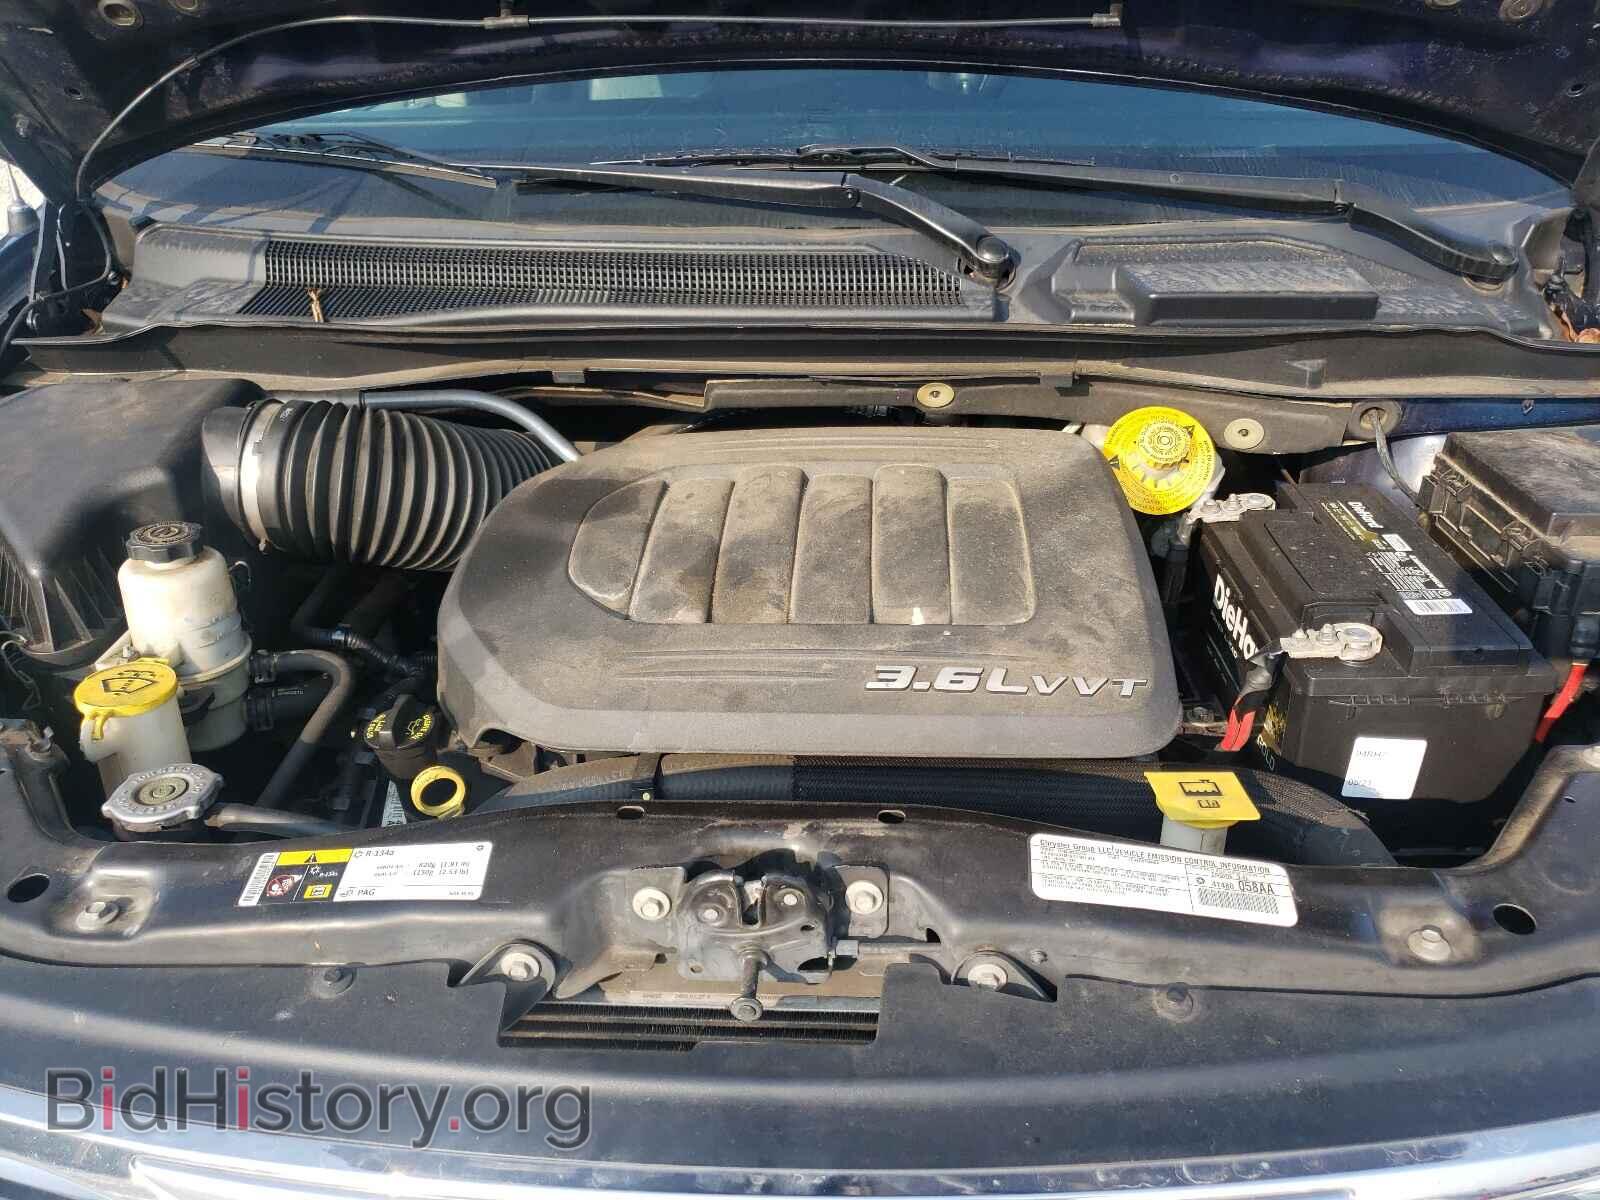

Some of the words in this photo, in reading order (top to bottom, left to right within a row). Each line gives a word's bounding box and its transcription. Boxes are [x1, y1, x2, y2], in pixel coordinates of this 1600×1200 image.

[1347, 502, 1384, 529] DieHard
[1213, 573, 1260, 661] DieHa
[864, 665, 1029, 695] 3.6L
[1031, 674, 1149, 699] VVT
[365, 849, 395, 857] R-134a
[1040, 840, 1070, 849] Chrysler
[1073, 844, 1095, 853] Group
[1147, 852, 1182, 864] EMISSION
[1185, 857, 1216, 867] CONTROL
[1219, 862, 1271, 874] INFORMATION
[357, 888, 376, 897] PAG
